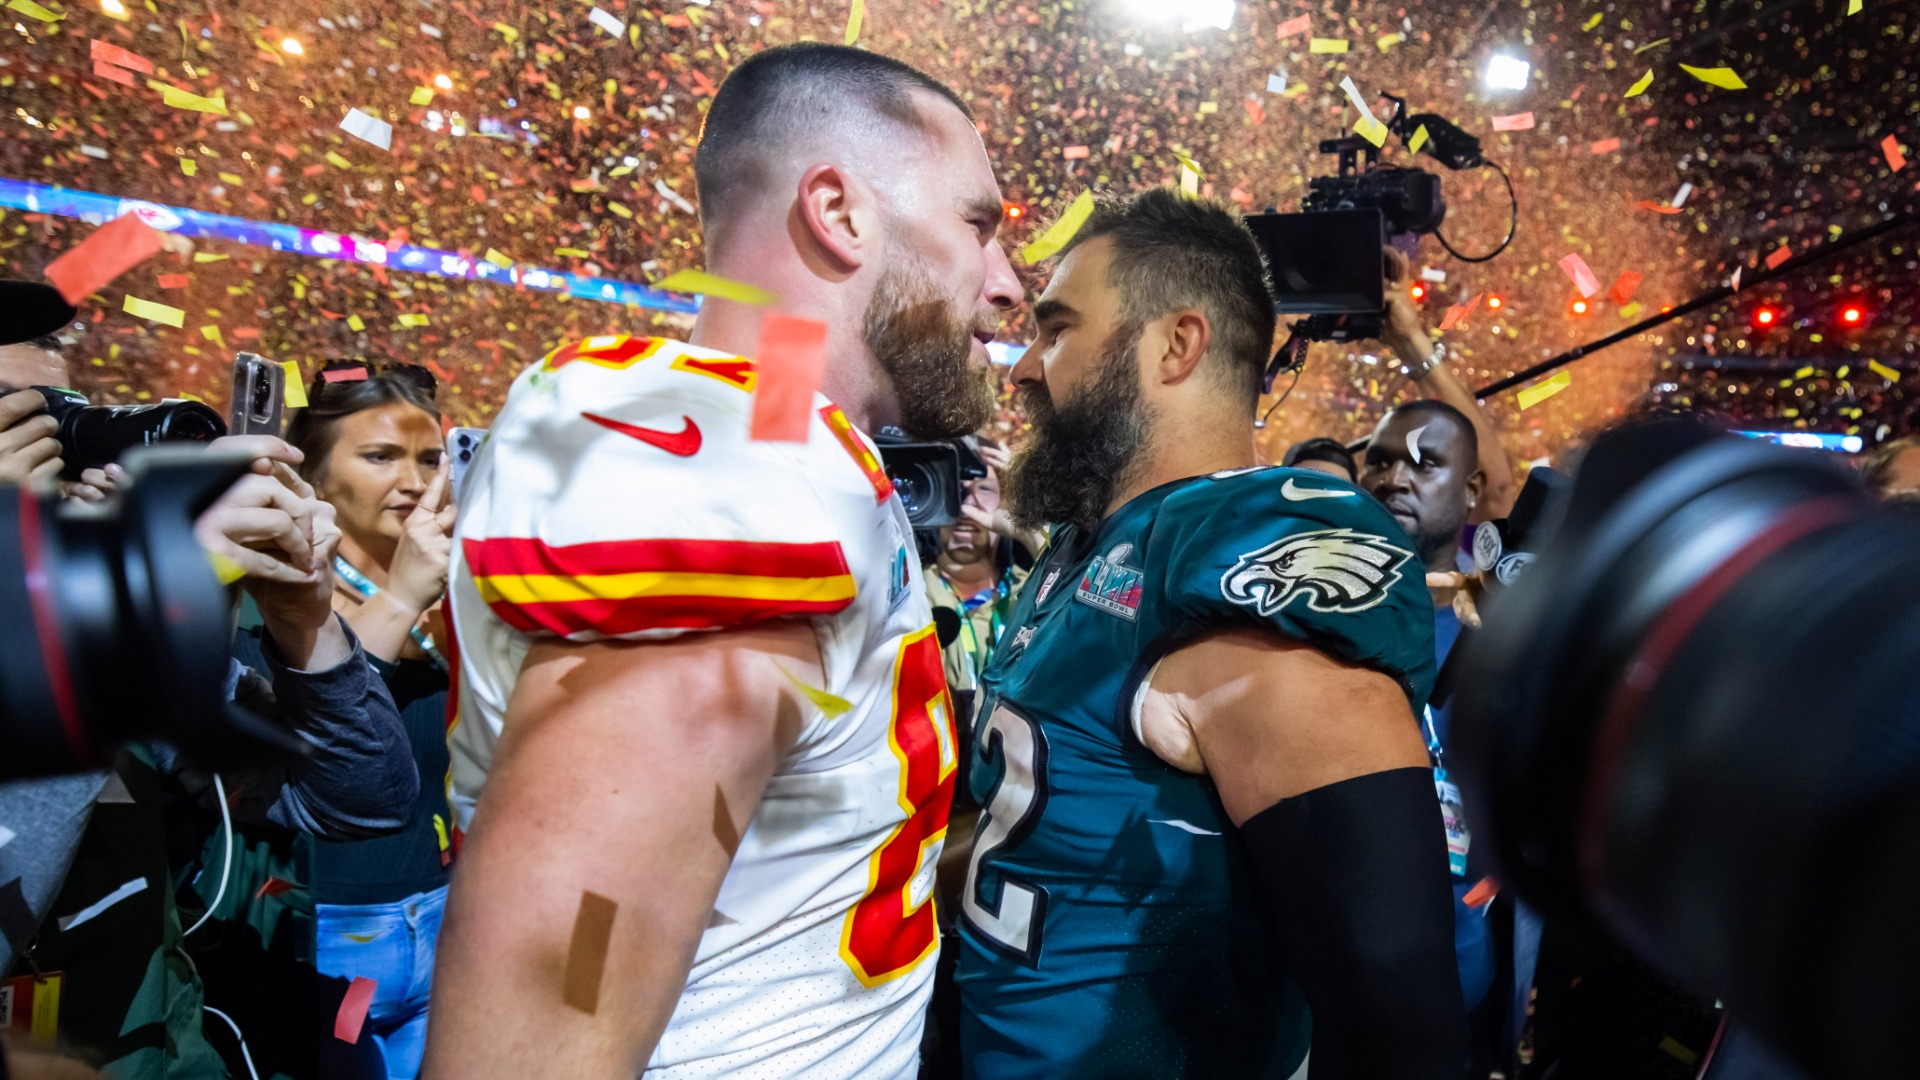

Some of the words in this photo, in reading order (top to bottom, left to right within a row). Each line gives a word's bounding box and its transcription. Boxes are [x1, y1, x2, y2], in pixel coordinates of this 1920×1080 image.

[1480, 528, 1497, 558] FOX
[1082, 592, 1107, 604] SUPER
[1108, 601, 1130, 614] BOWL
